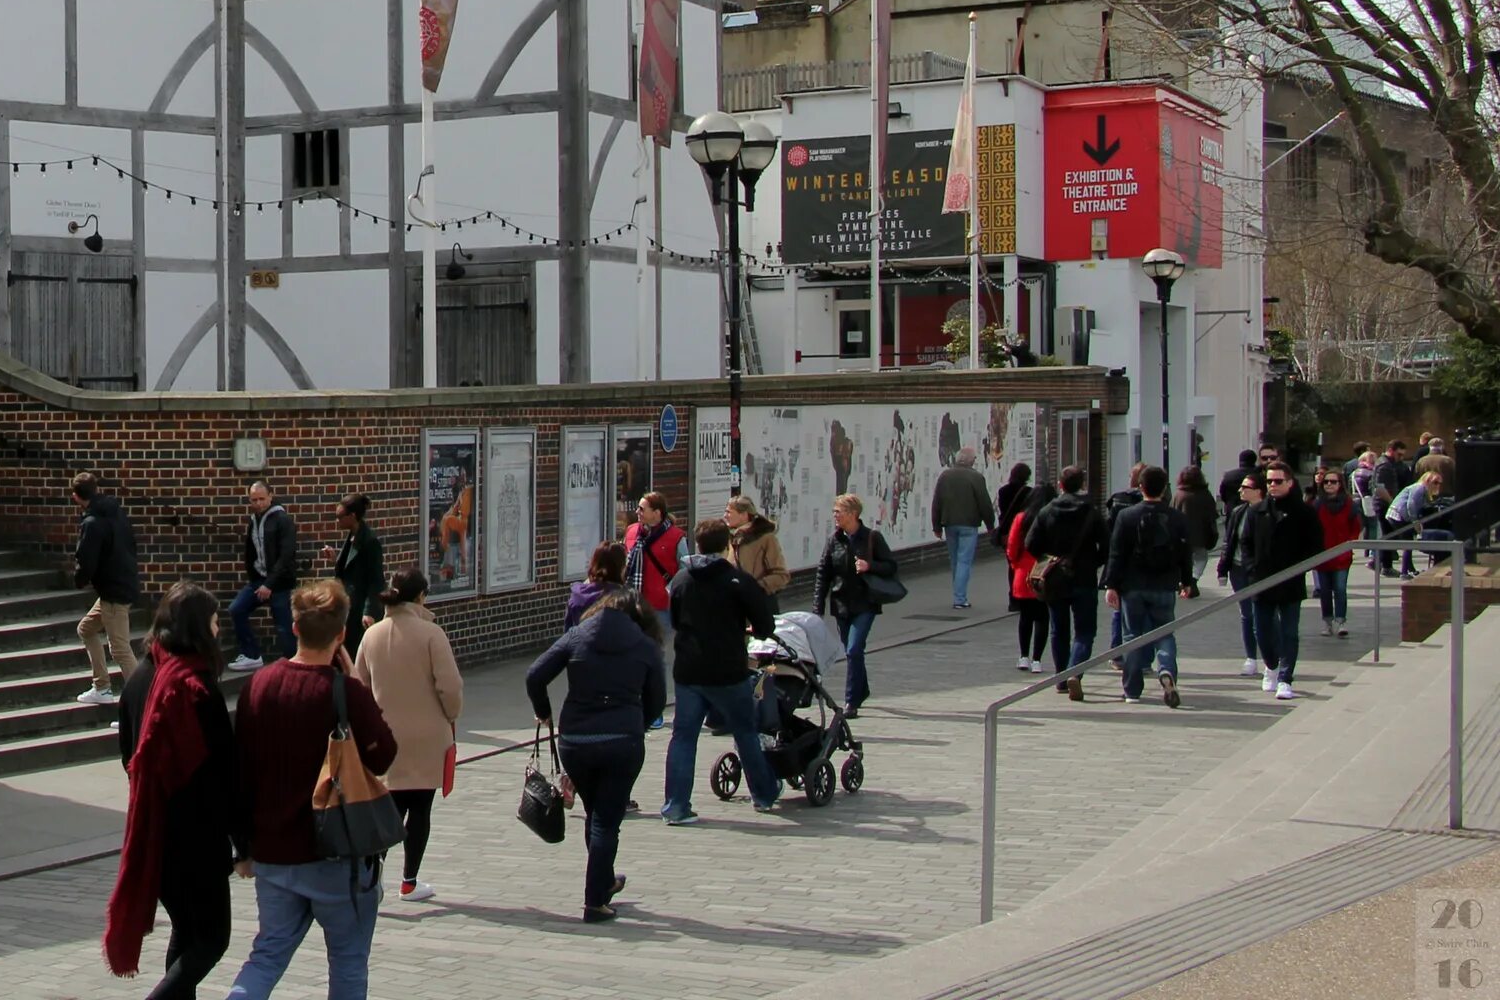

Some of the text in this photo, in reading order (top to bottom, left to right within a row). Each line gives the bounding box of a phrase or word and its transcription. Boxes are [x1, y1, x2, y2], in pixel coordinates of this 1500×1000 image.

[809, 154, 833, 162] PLAYHOUSE
[786, 167, 944, 192] WINTER EASO
[1064, 168, 1134, 184] EXHIBITION &
[840, 188, 921, 201] CANDLIGHT
[1062, 182, 1138, 199] THEATRE TOUR
[1073, 198, 1127, 214] ENTRANCE
[842, 209, 899, 221] PERILES
[837, 219, 904, 231] CYMBLINE
[811, 229, 932, 243] THE WINTR'S TALE
[830, 242, 912, 254] THE TEPEST
[699, 432, 731, 460] HAMLET
